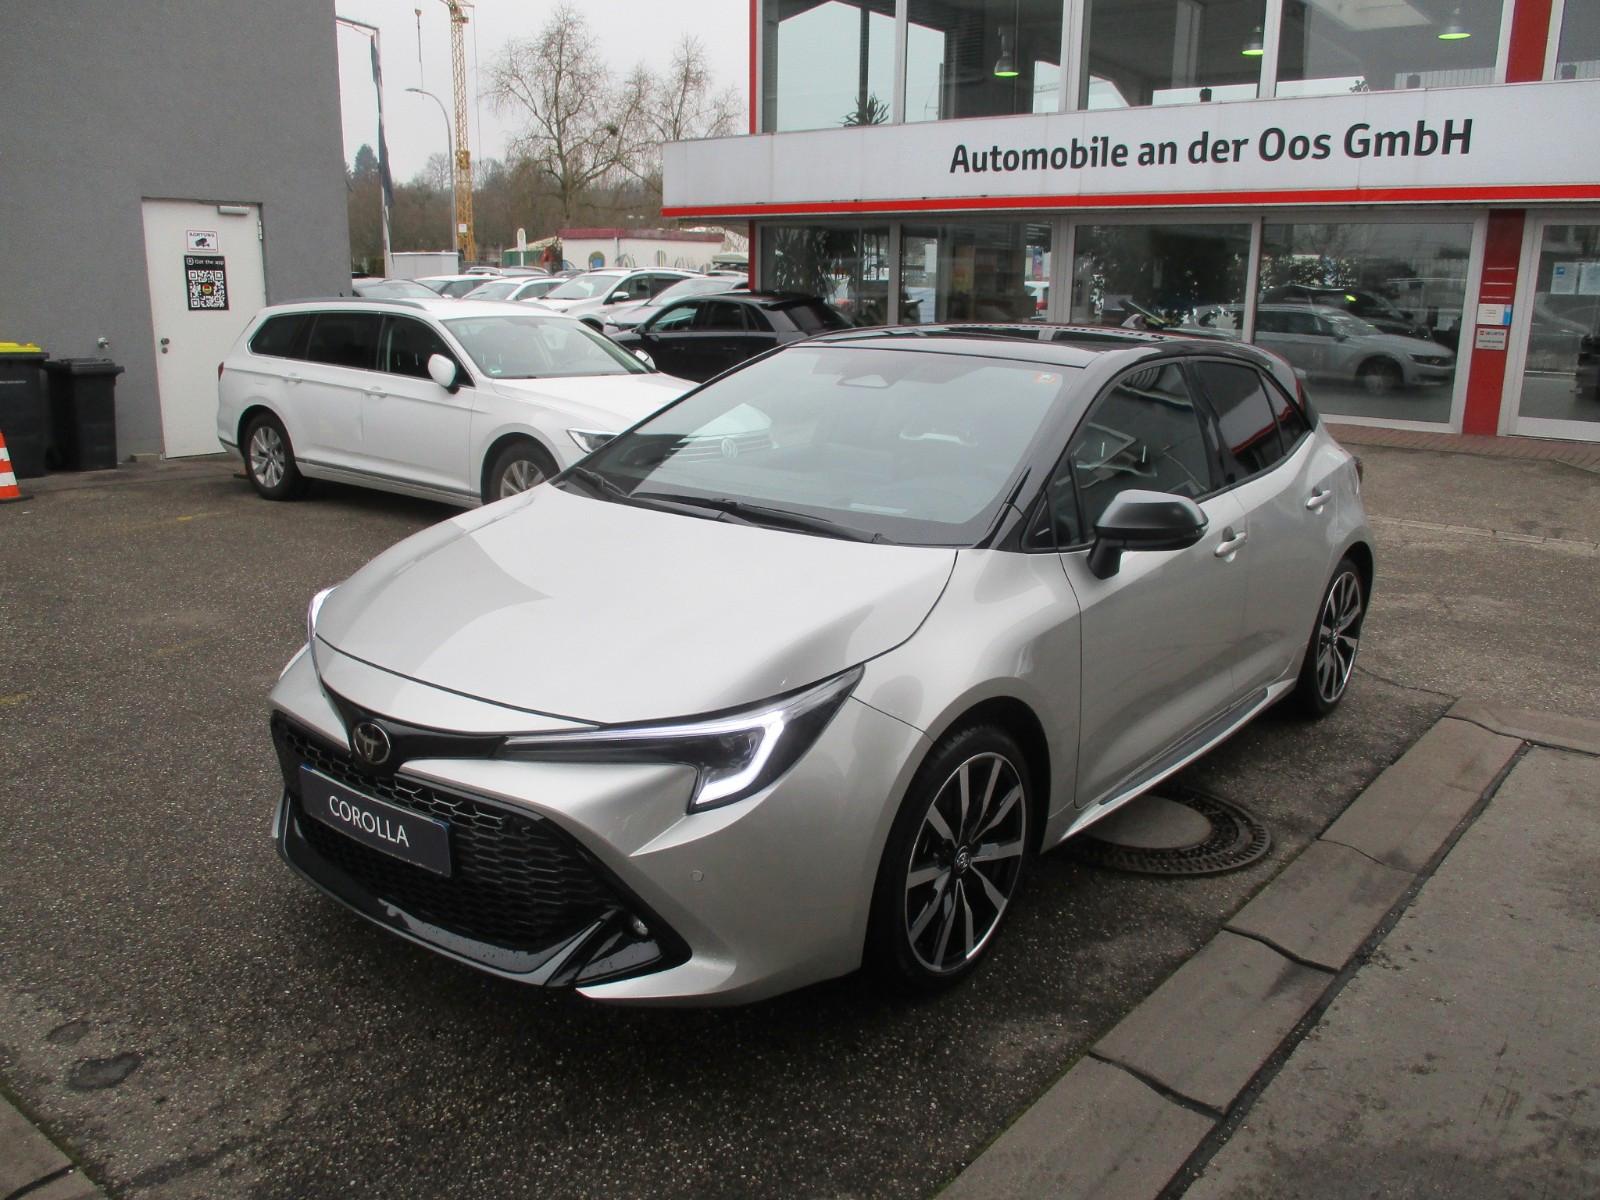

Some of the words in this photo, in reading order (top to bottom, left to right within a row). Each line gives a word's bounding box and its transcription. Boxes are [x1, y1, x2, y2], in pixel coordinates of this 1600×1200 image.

[950, 135, 1128, 173] Automobile
[1137, 140, 1177, 166] an
[1188, 131, 1249, 164] der
[1258, 127, 1332, 161] Oos
[1344, 118, 1473, 159] GmbH
[329, 795, 410, 848] COROLLA
